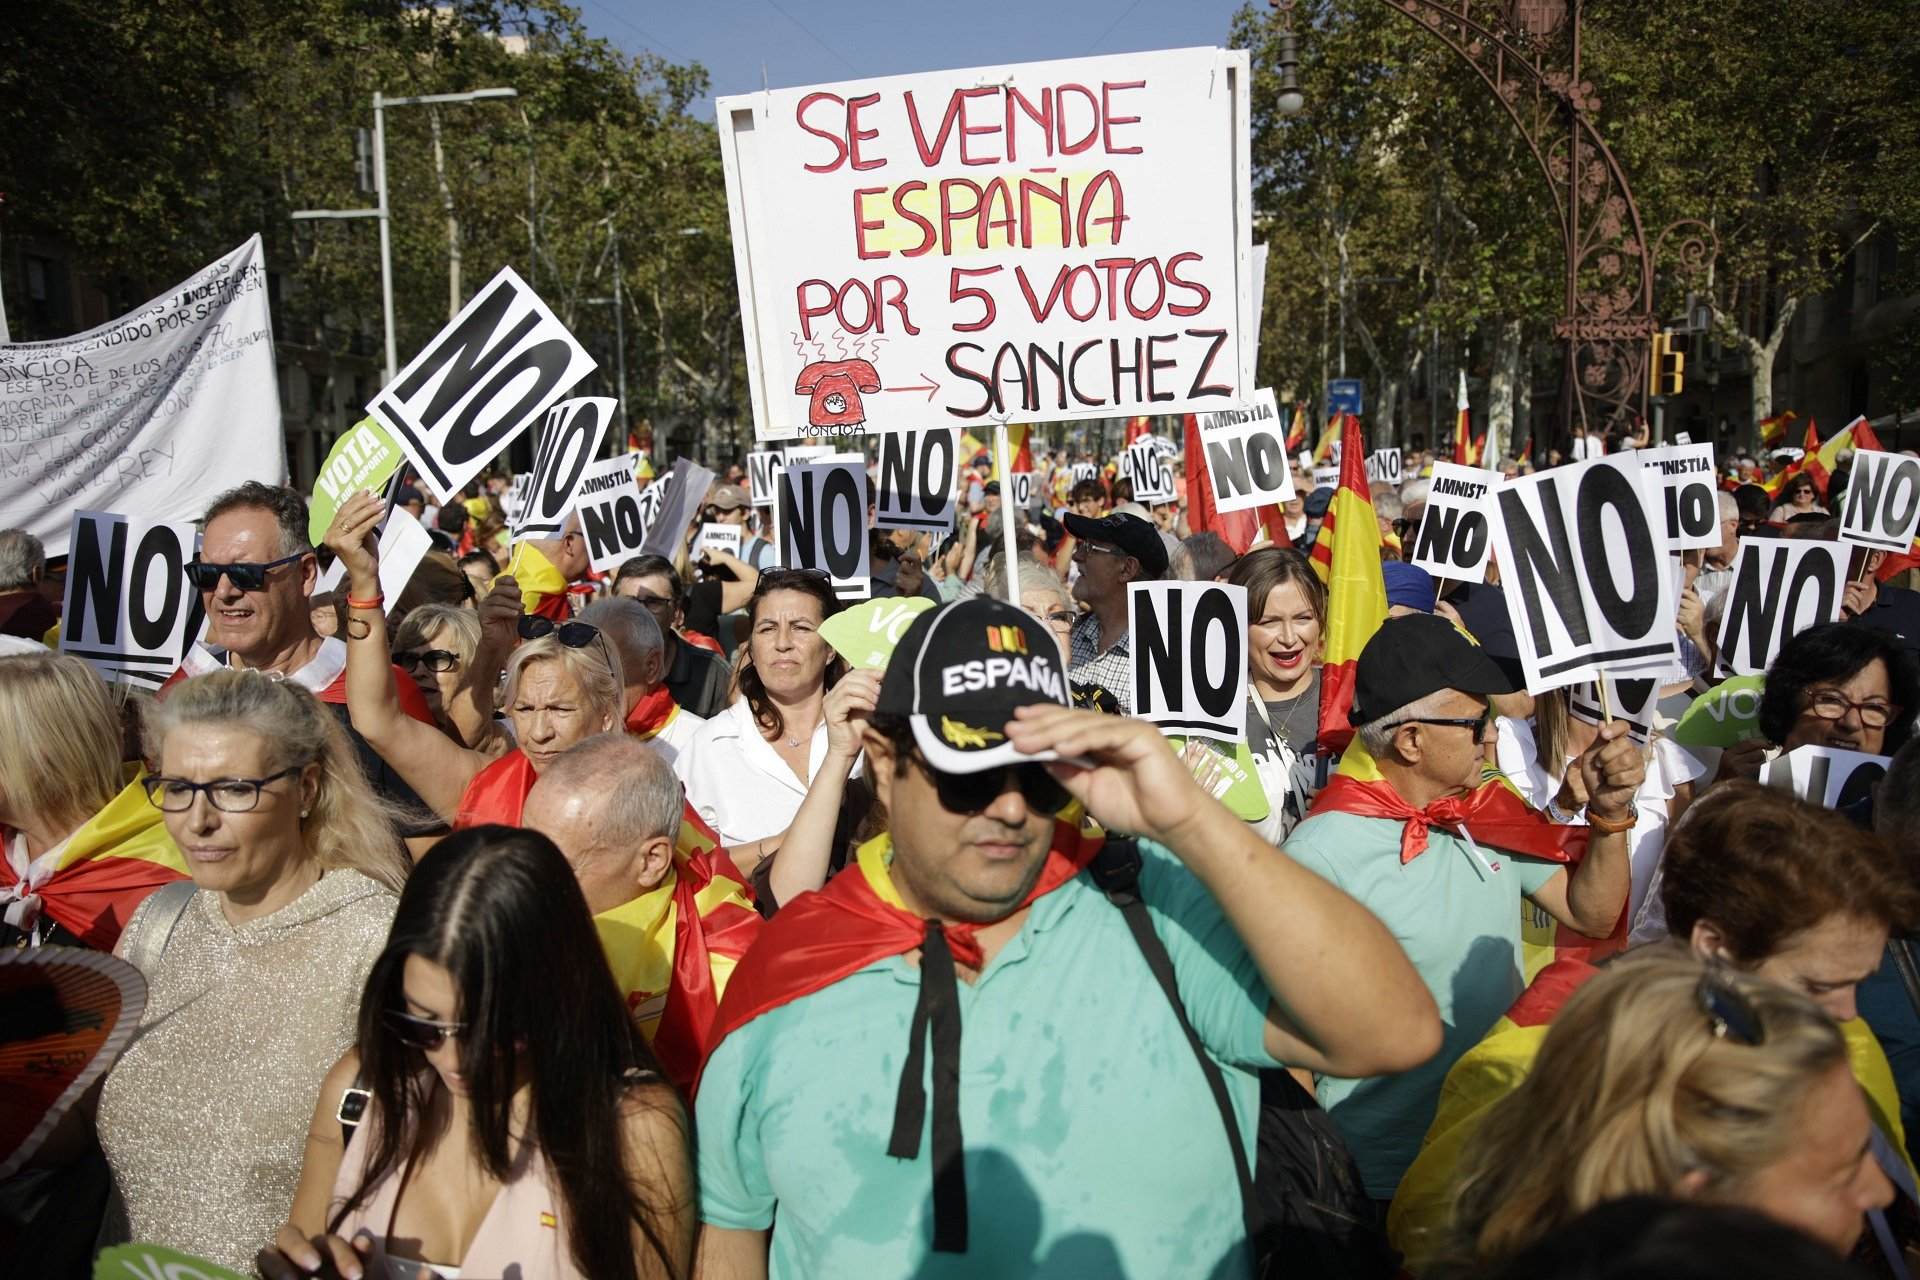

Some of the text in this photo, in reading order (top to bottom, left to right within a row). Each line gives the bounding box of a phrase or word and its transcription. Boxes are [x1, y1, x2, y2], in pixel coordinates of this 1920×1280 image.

[796, 79, 1146, 173] SE VENDE
[853, 167, 1130, 260] ESPAÑA
[155, 308, 194, 334] POR
[796, 251, 1212, 341] POR 5 VOTOS
[6, 380, 33, 394] ESE
[109, 366, 130, 380] DE
[133, 358, 161, 376] LOS
[393, 279, 573, 466] NO
[944, 328, 1235, 418] SANCHEZ
[115, 440, 175, 490] REY
[319, 423, 381, 500] VOTA
[353, 446, 390, 486] IMPORTA
[518, 401, 599, 519] NO
[797, 422, 867, 438] MONCLOA
[1131, 447, 1160, 491] NO
[1207, 431, 1285, 500] NO
[1377, 450, 1399, 480] NO
[879, 427, 954, 516] NO
[1844, 453, 1920, 538] NO
[581, 495, 643, 561] NO
[777, 467, 863, 580] NO
[1415, 504, 1489, 569] NO
[1497, 463, 1659, 660] NO
[65, 518, 184, 651] NO
[1721, 544, 1836, 670] NO
[942, 655, 1066, 706] ESPAÑA
[1134, 588, 1241, 718] NO
[1705, 688, 1765, 723] VO
